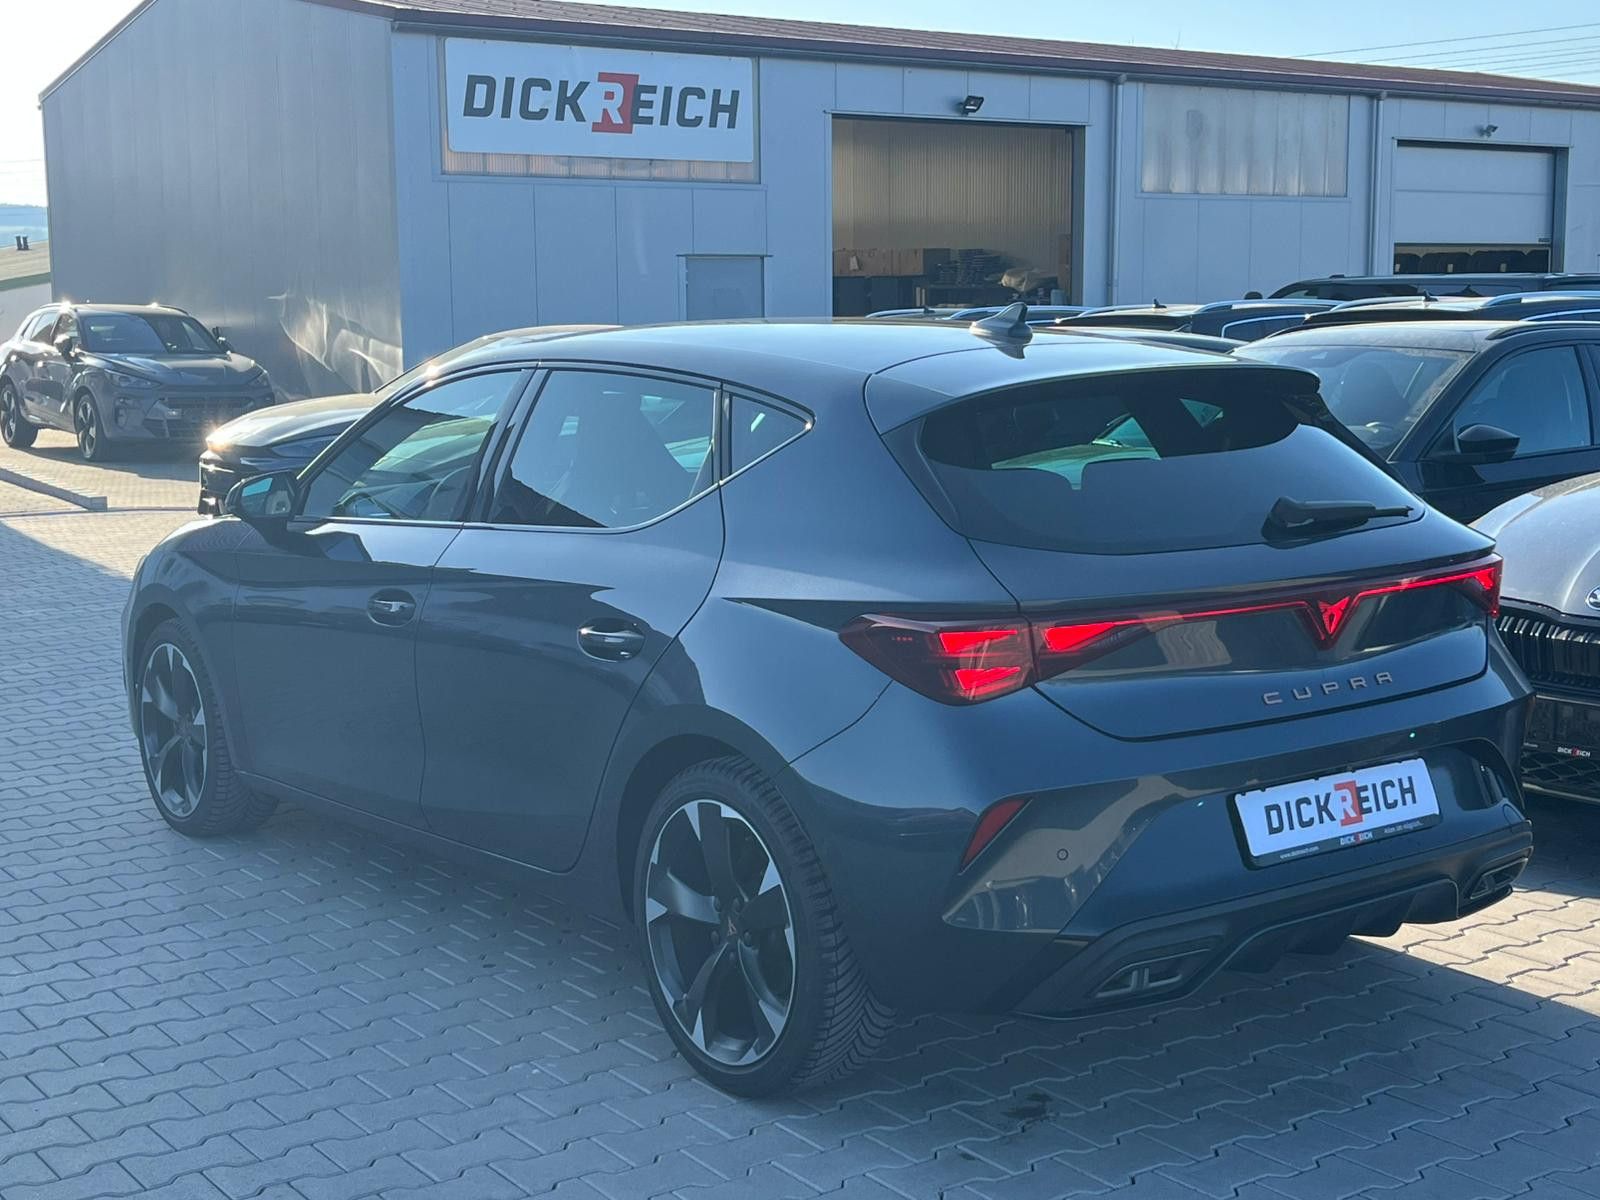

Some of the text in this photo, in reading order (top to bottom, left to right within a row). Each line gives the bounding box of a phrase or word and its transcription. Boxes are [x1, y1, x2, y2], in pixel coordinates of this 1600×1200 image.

[463, 72, 740, 134] DICKREICH
[1263, 672, 1393, 705] CUPRA
[1264, 776, 1417, 835] DICKREICH
